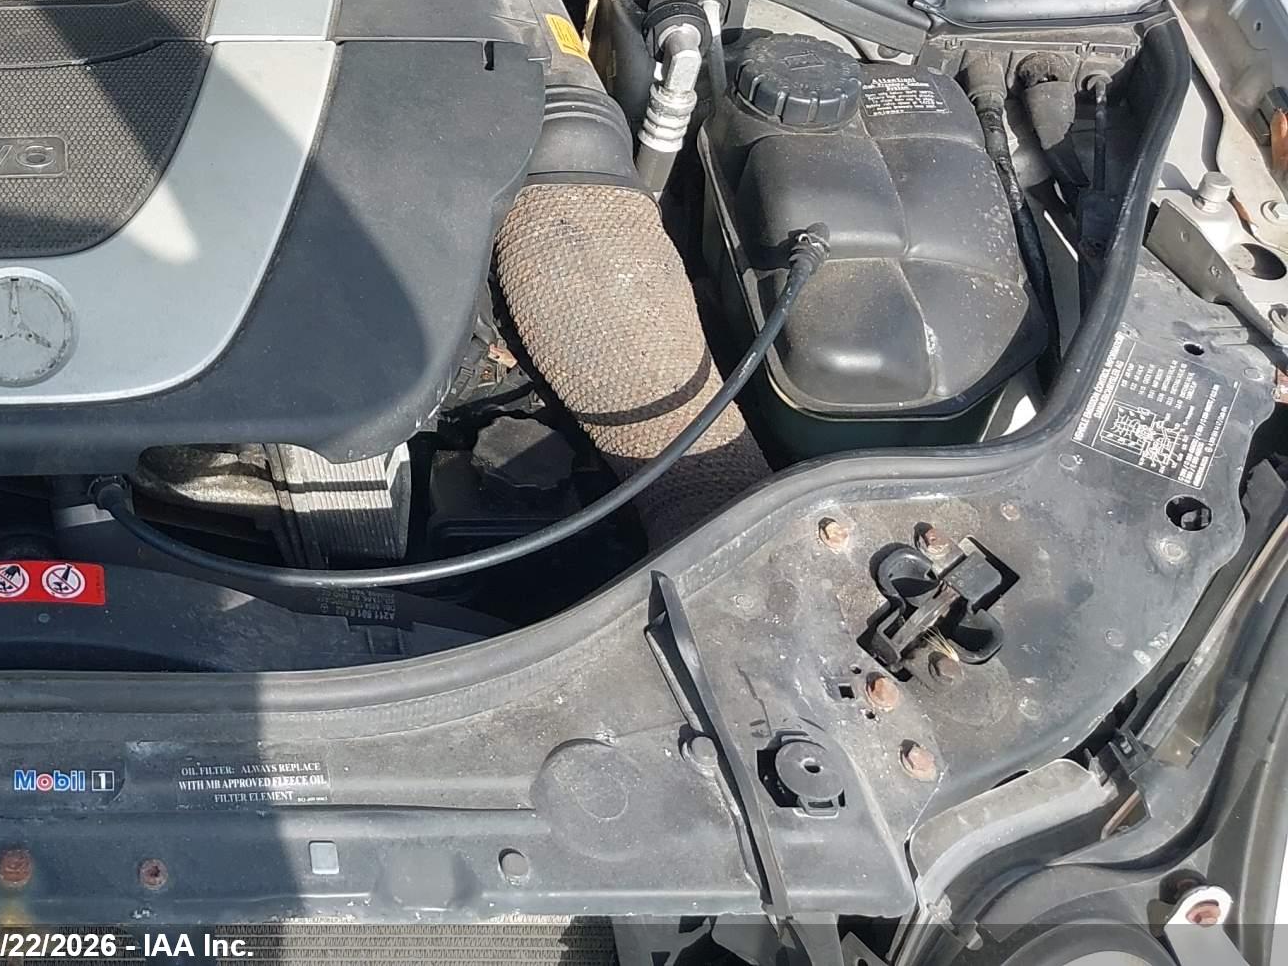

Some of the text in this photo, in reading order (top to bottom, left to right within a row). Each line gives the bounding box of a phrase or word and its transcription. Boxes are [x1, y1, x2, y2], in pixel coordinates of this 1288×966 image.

[1093, 366, 1111, 392] CONTROL
[181, 762, 321, 776] OIL FILTER: ALWAYS REPLACE
[14, 769, 85, 791] Mobil
[178, 774, 327, 790] WITH MB APPROVED FLEECE OIL
[214, 793, 247, 803] FILTER
[249, 790, 293, 802] ELEMENT
